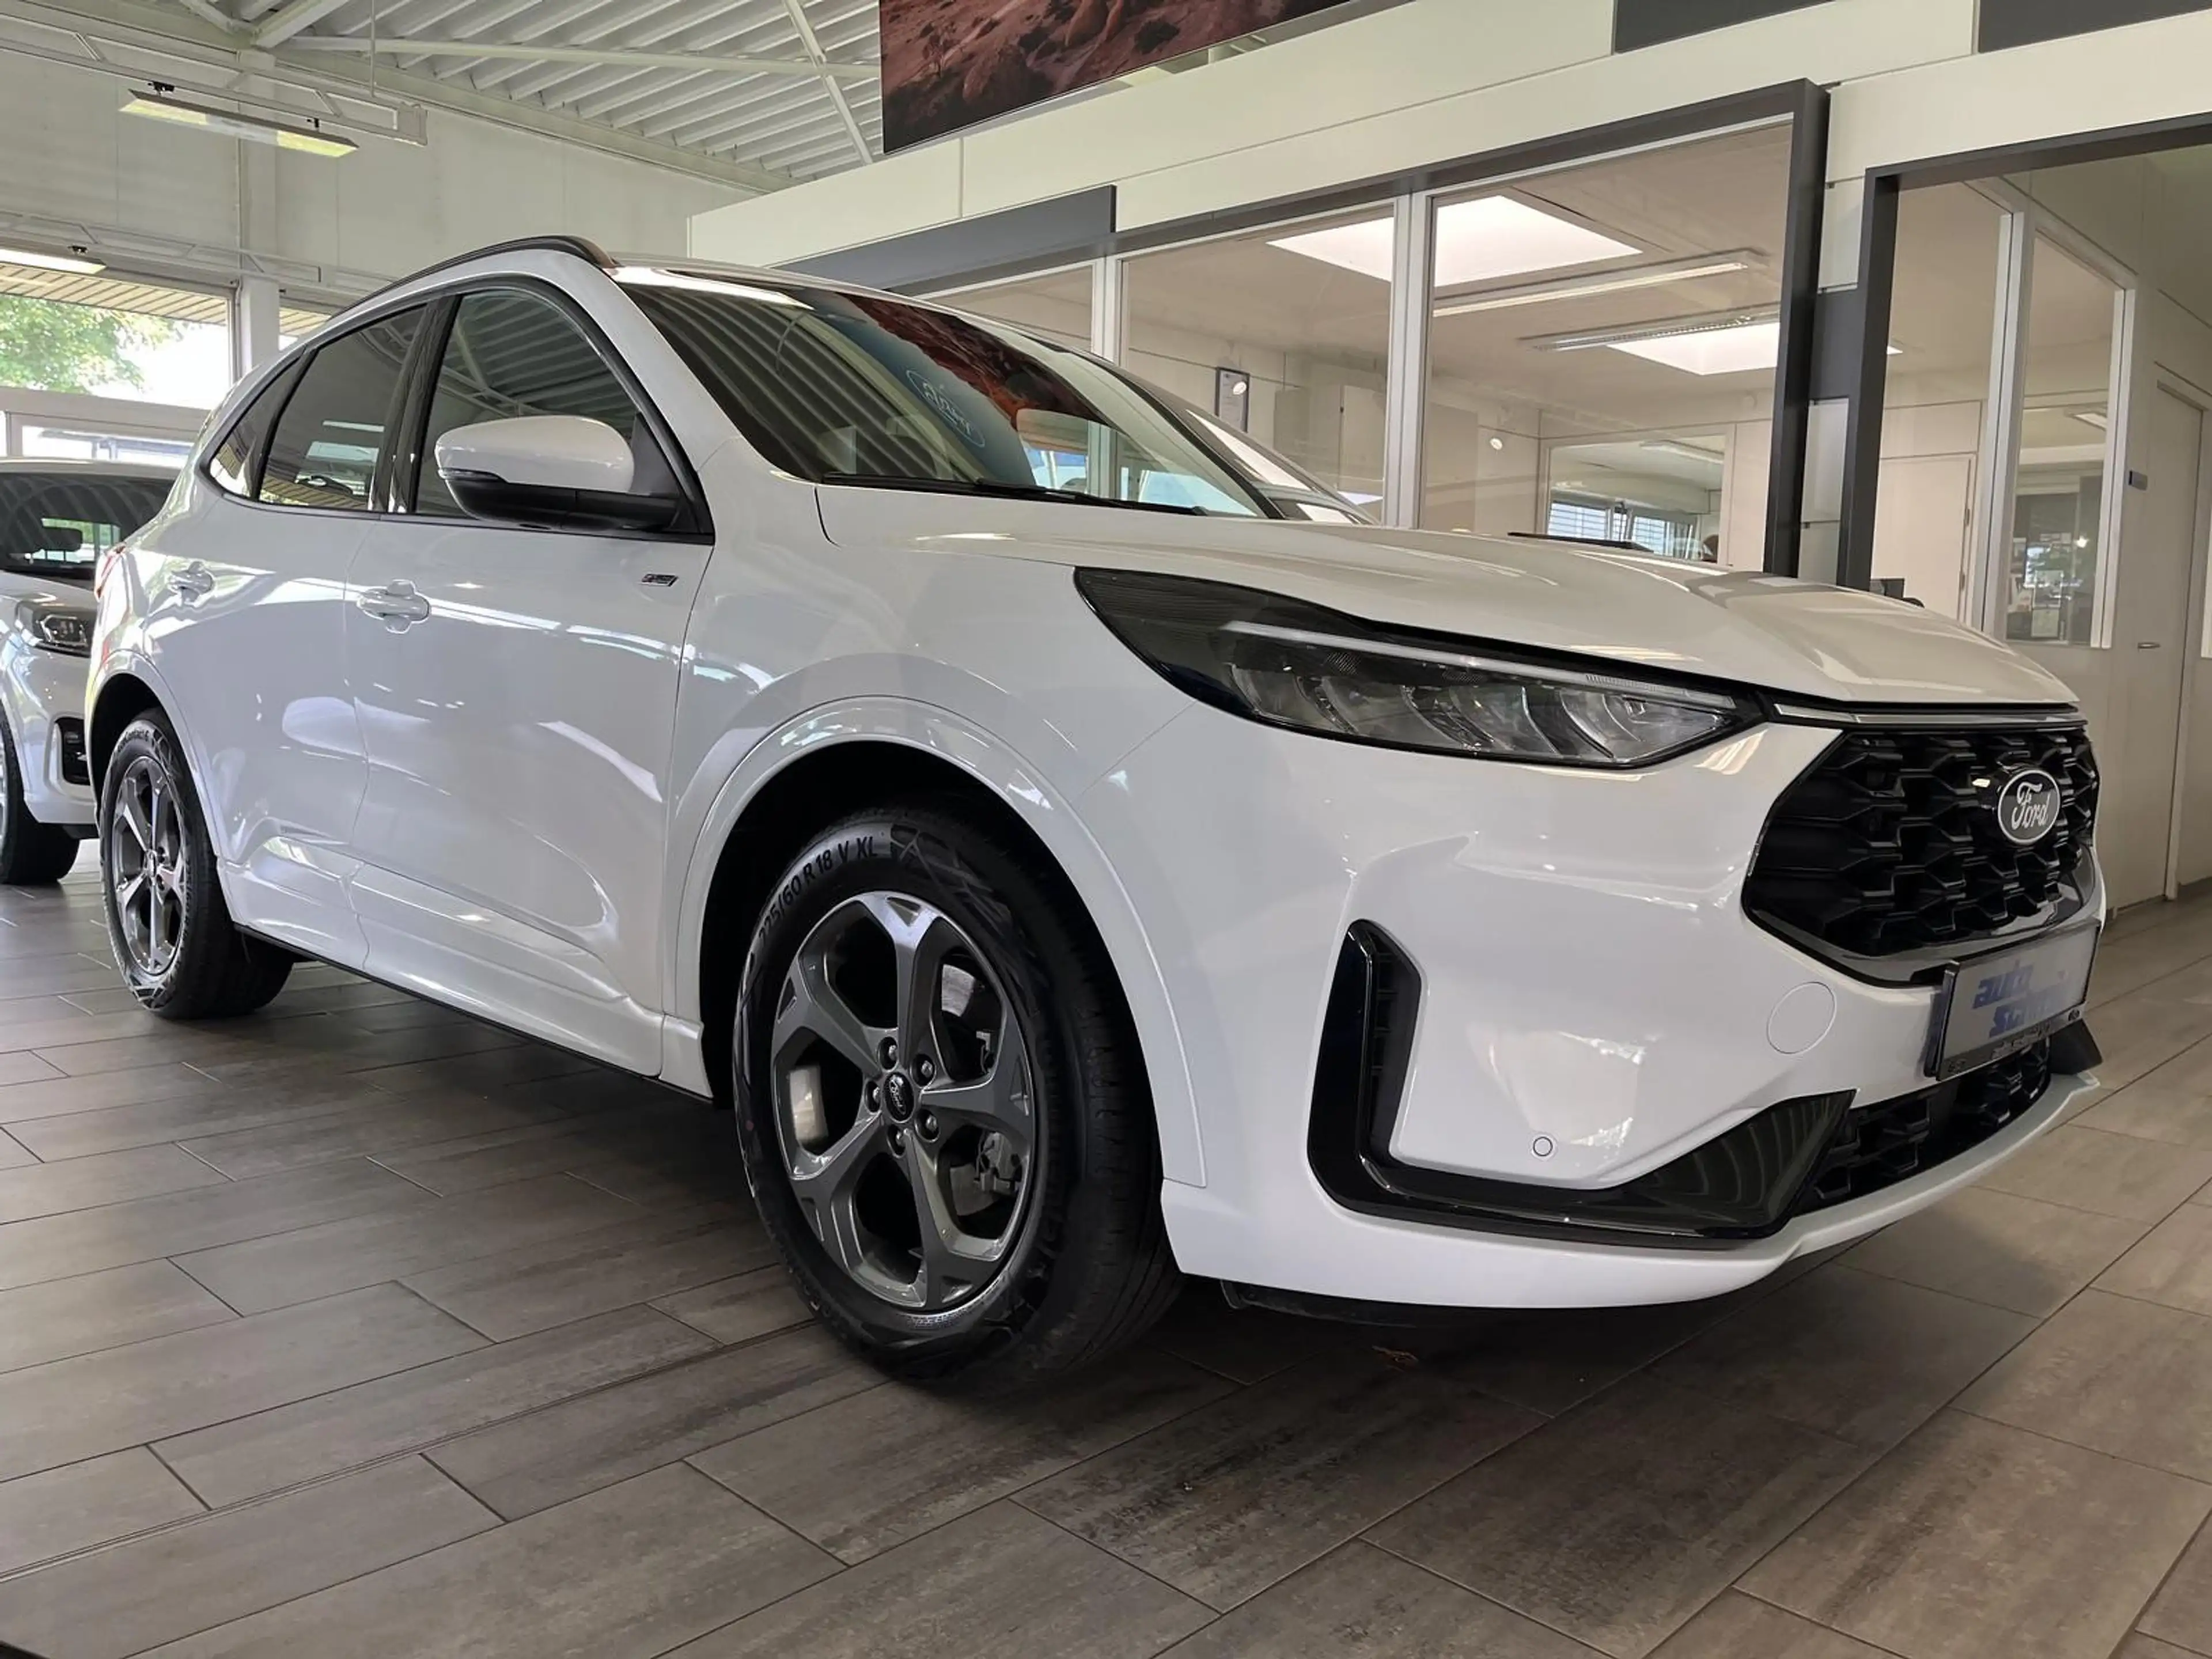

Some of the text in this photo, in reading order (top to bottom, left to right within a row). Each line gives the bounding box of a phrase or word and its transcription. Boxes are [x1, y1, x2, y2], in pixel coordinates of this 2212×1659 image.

[2011, 781, 2051, 830] Ford
[757, 836, 878, 945] 225/60 R 18 V XL
